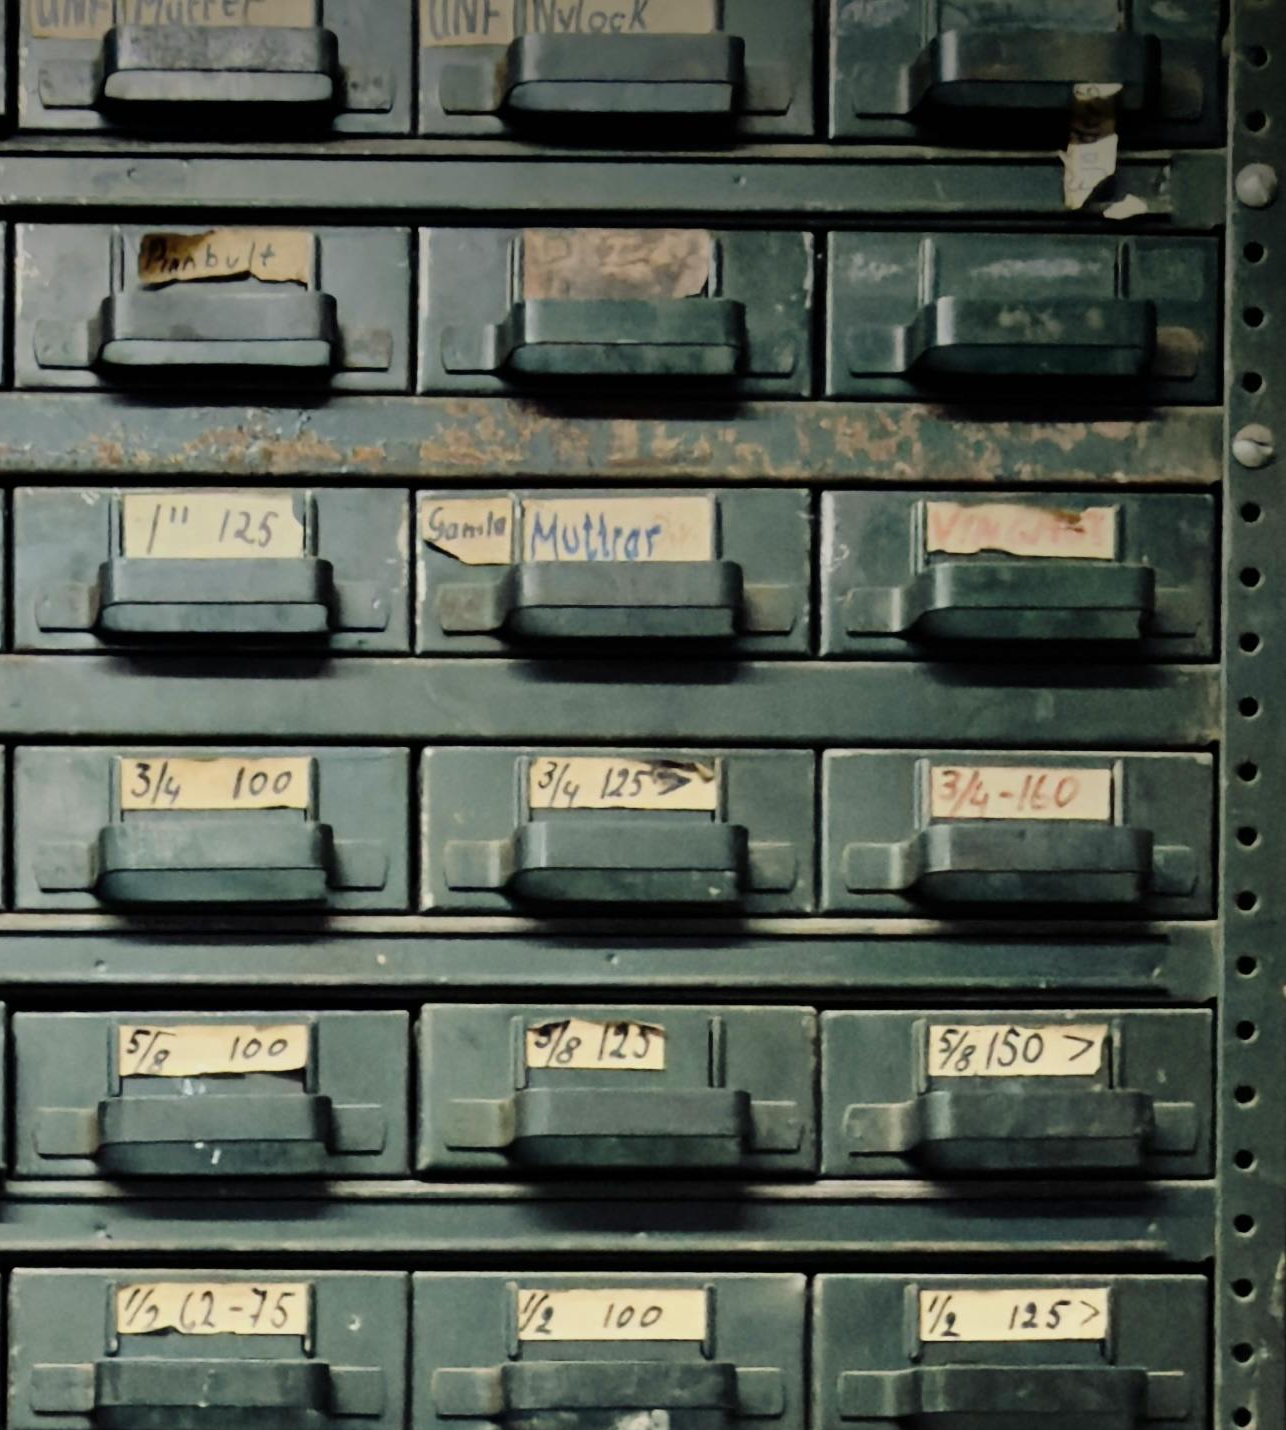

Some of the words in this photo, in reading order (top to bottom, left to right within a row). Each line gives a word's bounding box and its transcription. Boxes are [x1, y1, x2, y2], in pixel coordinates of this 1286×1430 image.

[429, 0, 501, 38] UNF
[219, 513, 274, 547] 125
[131, 762, 180, 804] 3/4
[232, 768, 291, 798] 100
[538, 760, 580, 806] 3/4
[601, 765, 649, 799] 125
[229, 1037, 288, 1060] 100
[938, 1030, 976, 1072] 5/8
[986, 1029, 1044, 1067] 150
[124, 1288, 159, 1329] 1/2
[520, 1294, 554, 1334] 1/2
[604, 1305, 662, 1329] 100
[927, 1296, 958, 1337] 1/2
[1010, 1298, 1062, 1330] 125
